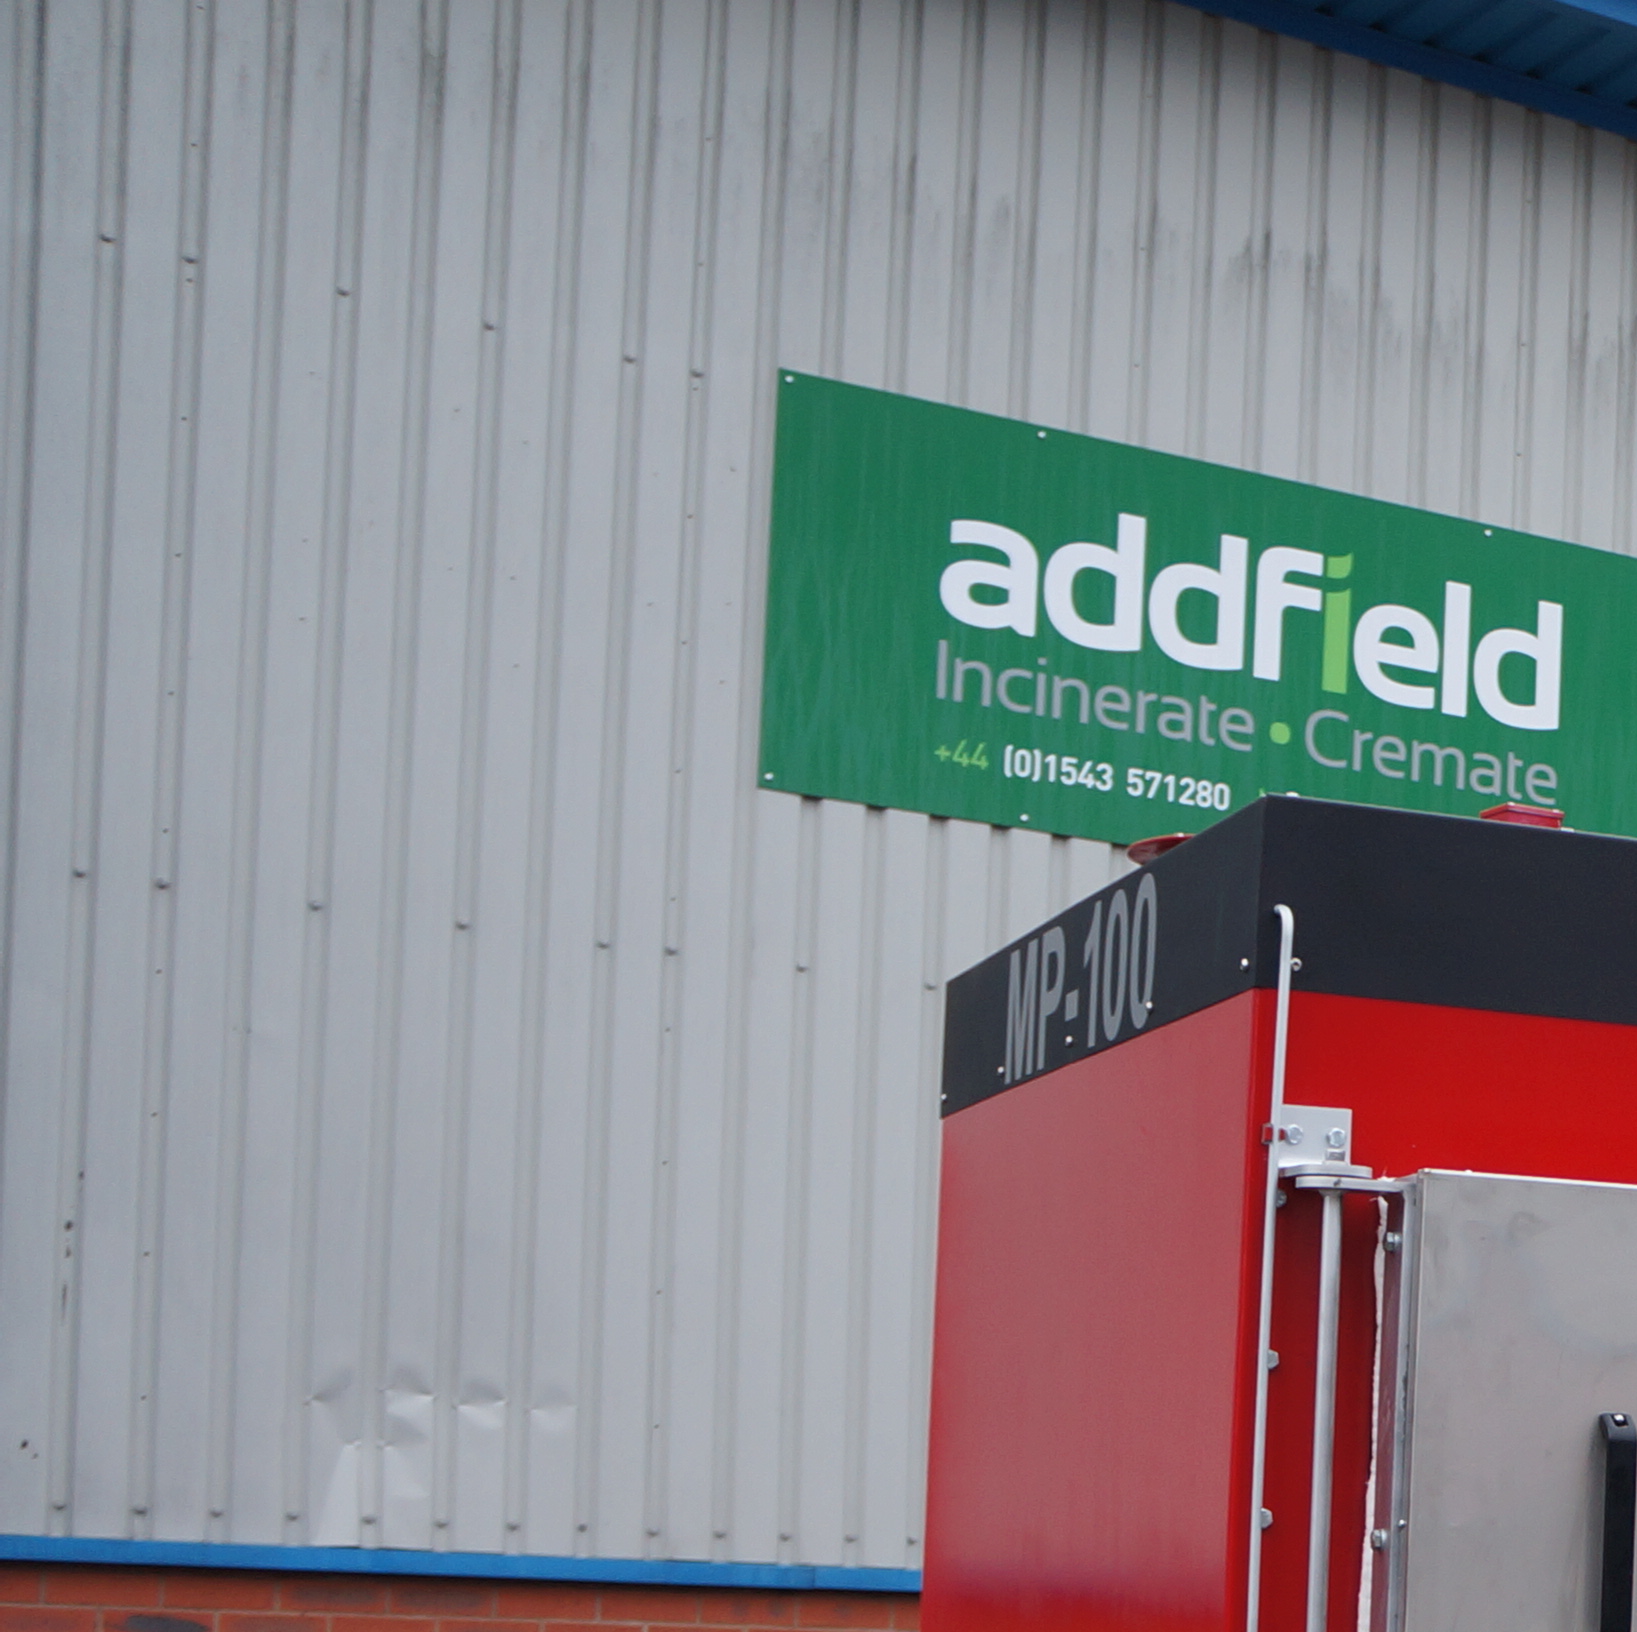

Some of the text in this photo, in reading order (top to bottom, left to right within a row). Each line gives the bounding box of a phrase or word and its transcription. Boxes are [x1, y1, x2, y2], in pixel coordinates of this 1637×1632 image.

[940, 512, 1563, 731] addfield
[934, 739, 1231, 811] +44 (0)1543 571280
[935, 639, 1558, 805] Incinerate Cremate
[1004, 872, 1157, 1085] MP-100
